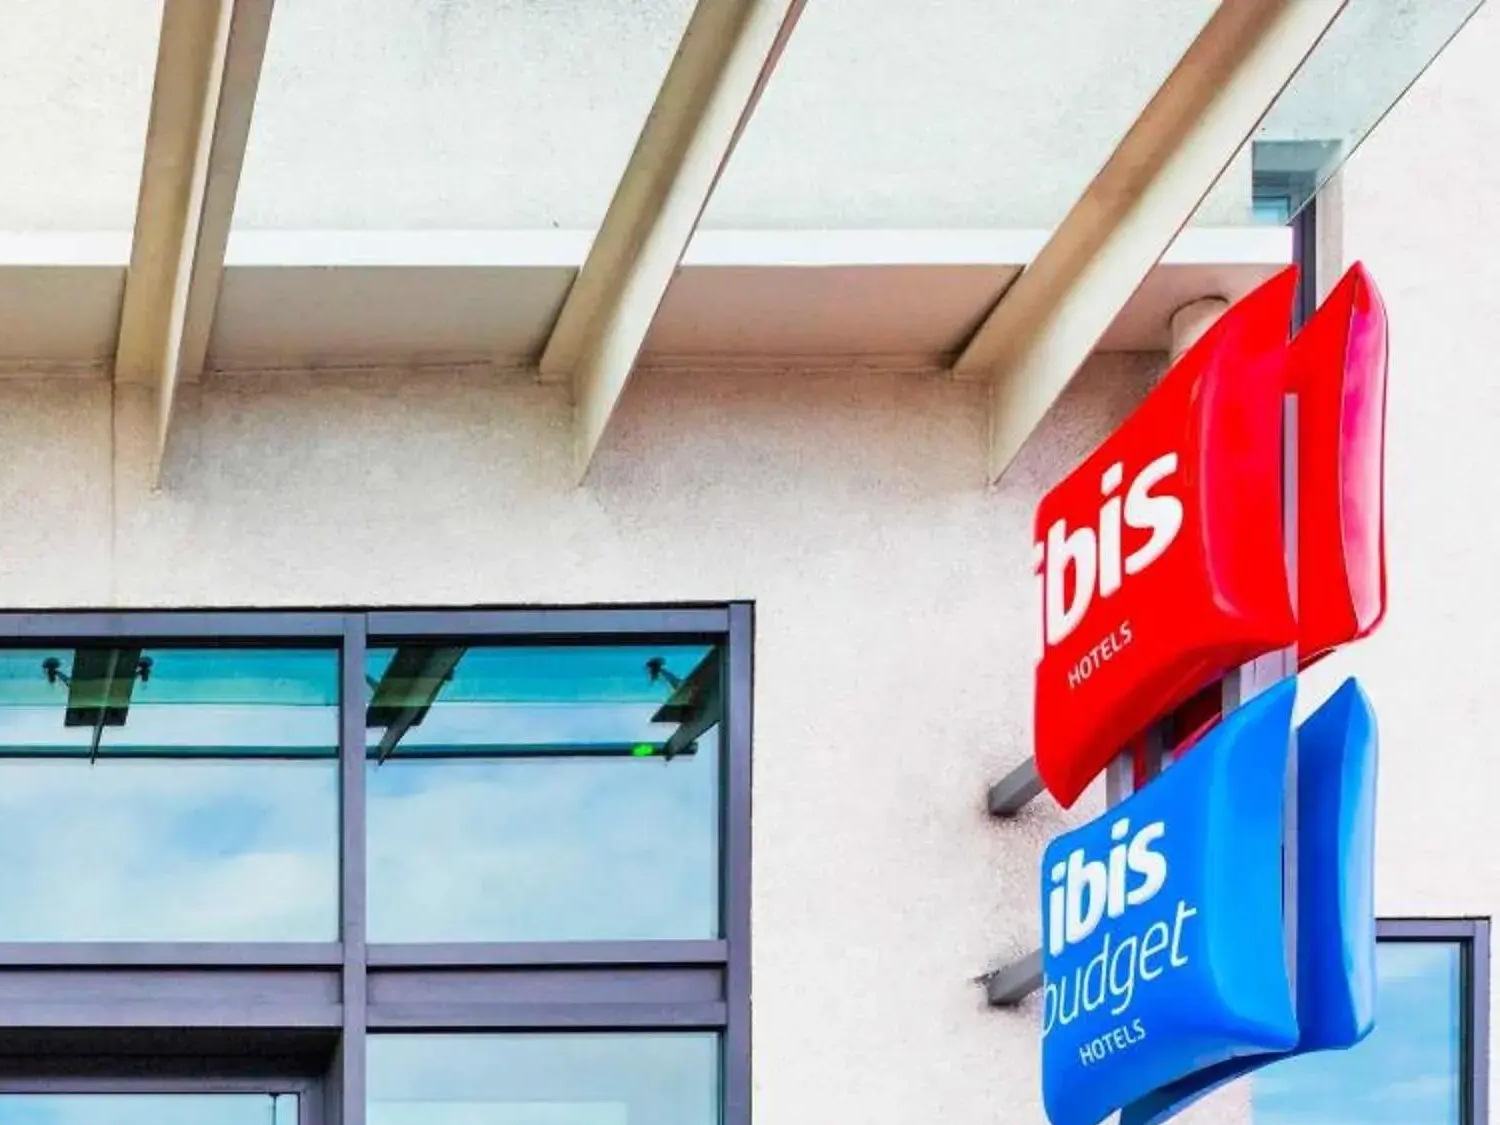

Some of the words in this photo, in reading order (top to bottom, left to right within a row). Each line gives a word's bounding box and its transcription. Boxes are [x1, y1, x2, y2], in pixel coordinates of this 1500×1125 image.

[1067, 619, 1134, 689] HOTELS
[1048, 816, 1167, 957] ibis
[1042, 899, 1198, 1038] budget
[1078, 1017, 1147, 1066] HOTELS
